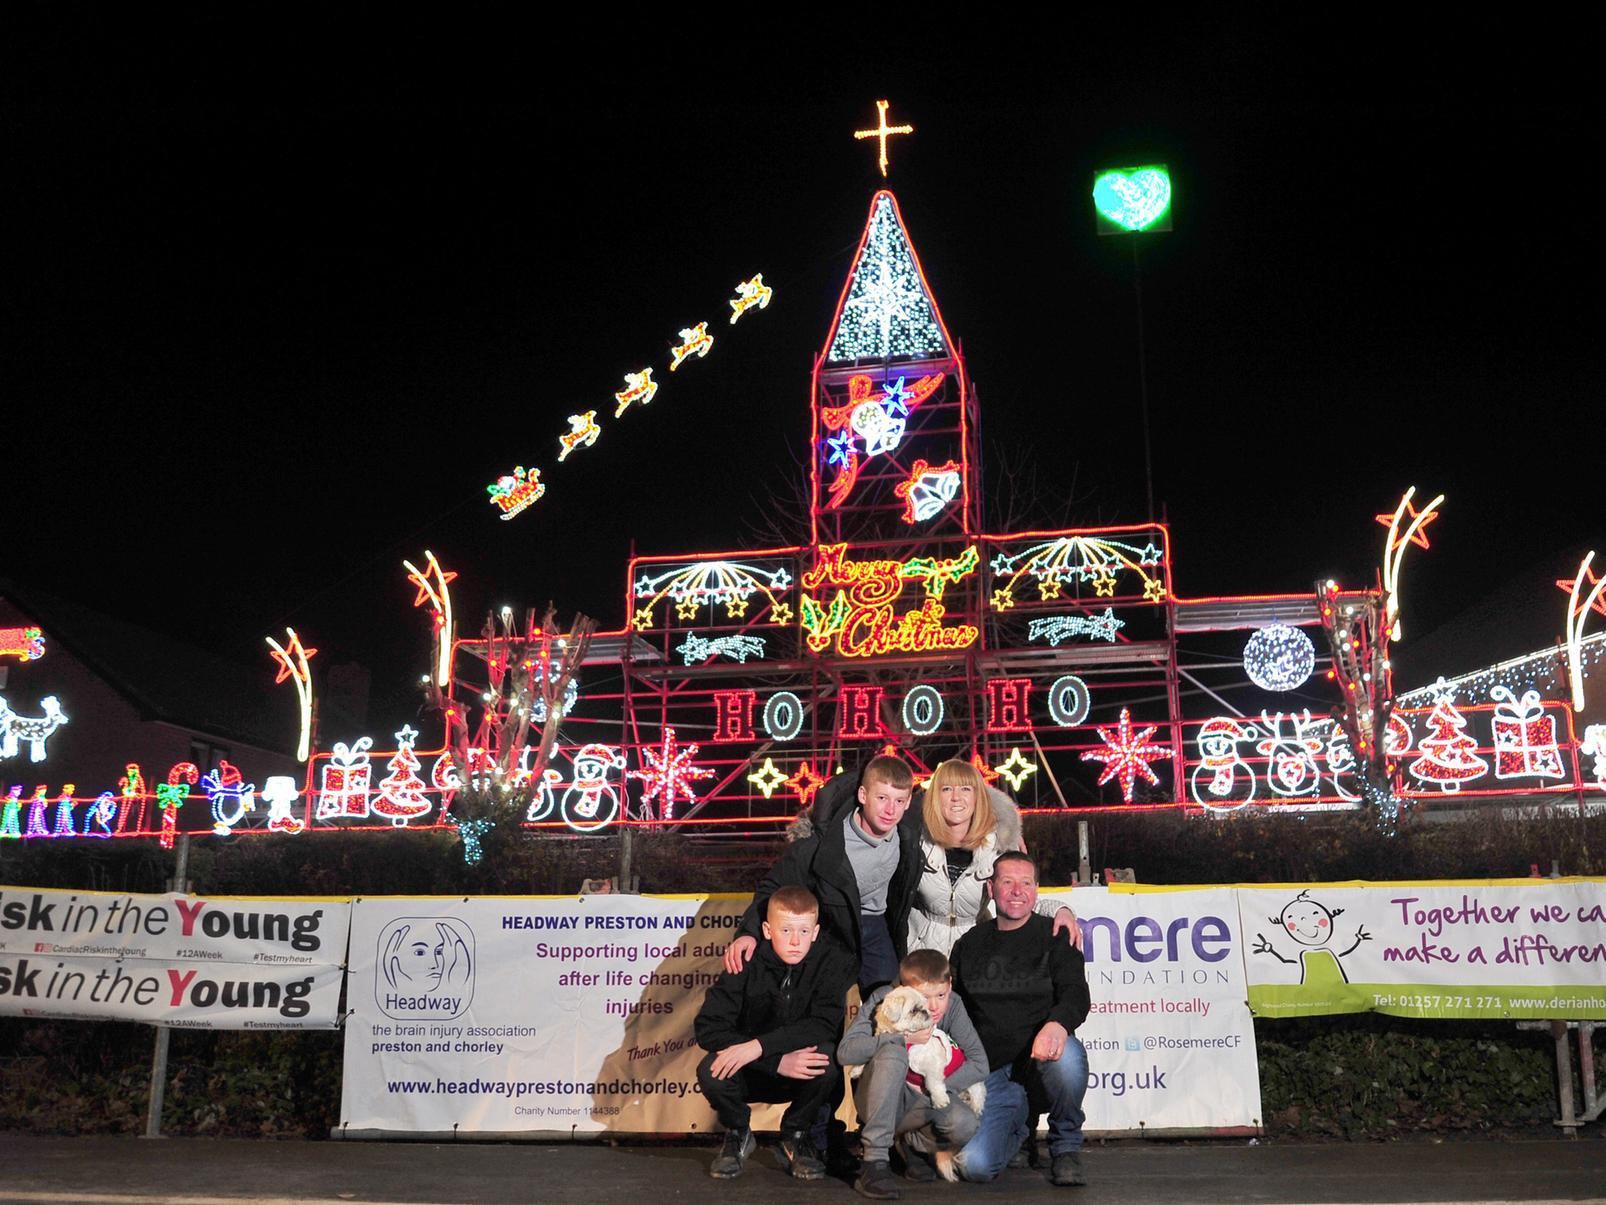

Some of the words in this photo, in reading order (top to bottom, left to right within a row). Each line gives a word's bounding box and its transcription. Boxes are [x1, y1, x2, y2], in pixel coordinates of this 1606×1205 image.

[0, 892, 56, 931] sk
[174, 899, 323, 951] Young
[502, 916, 579, 929] HEADWAY
[585, 916, 657, 929] PRESTON
[663, 916, 695, 929] AND
[1390, 895, 1520, 937] Together
[1530, 905, 1570, 923] we
[176, 950, 223, 959] #12AWeek
[536, 943, 638, 961] Supporting
[644, 943, 687, 958] local
[1383, 932, 1460, 964] make
[1467, 946, 1487, 964] a
[253, 953, 312, 963] #Testmyheart
[559, 971, 600, 985] after
[606, 970, 633, 985] life
[167, 969, 314, 1018] Young
[1373, 994, 1396, 1007] Tel:
[1400, 995, 1440, 1008] 01257
[1446, 996, 1472, 1008] 271
[1476, 996, 1502, 1008] 271
[386, 993, 461, 1014] Headway
[606, 999, 674, 1017] injuries
[1161, 998, 1210, 1016] locally
[372, 1025, 391, 1036] the
[395, 1025, 425, 1036] brain
[430, 1025, 463, 1039] injury
[466, 1025, 536, 1037] association
[372, 1041, 421, 1054] preston
[425, 1041, 450, 1052] and
[454, 1041, 503, 1055] chorley
[627, 1043, 660, 1061] Thank
[663, 1039, 684, 1054] You
[1143, 1035, 1241, 1050] @RosemereCF
[514, 1106, 545, 1117] Charity
[547, 1106, 580, 1116] Number
